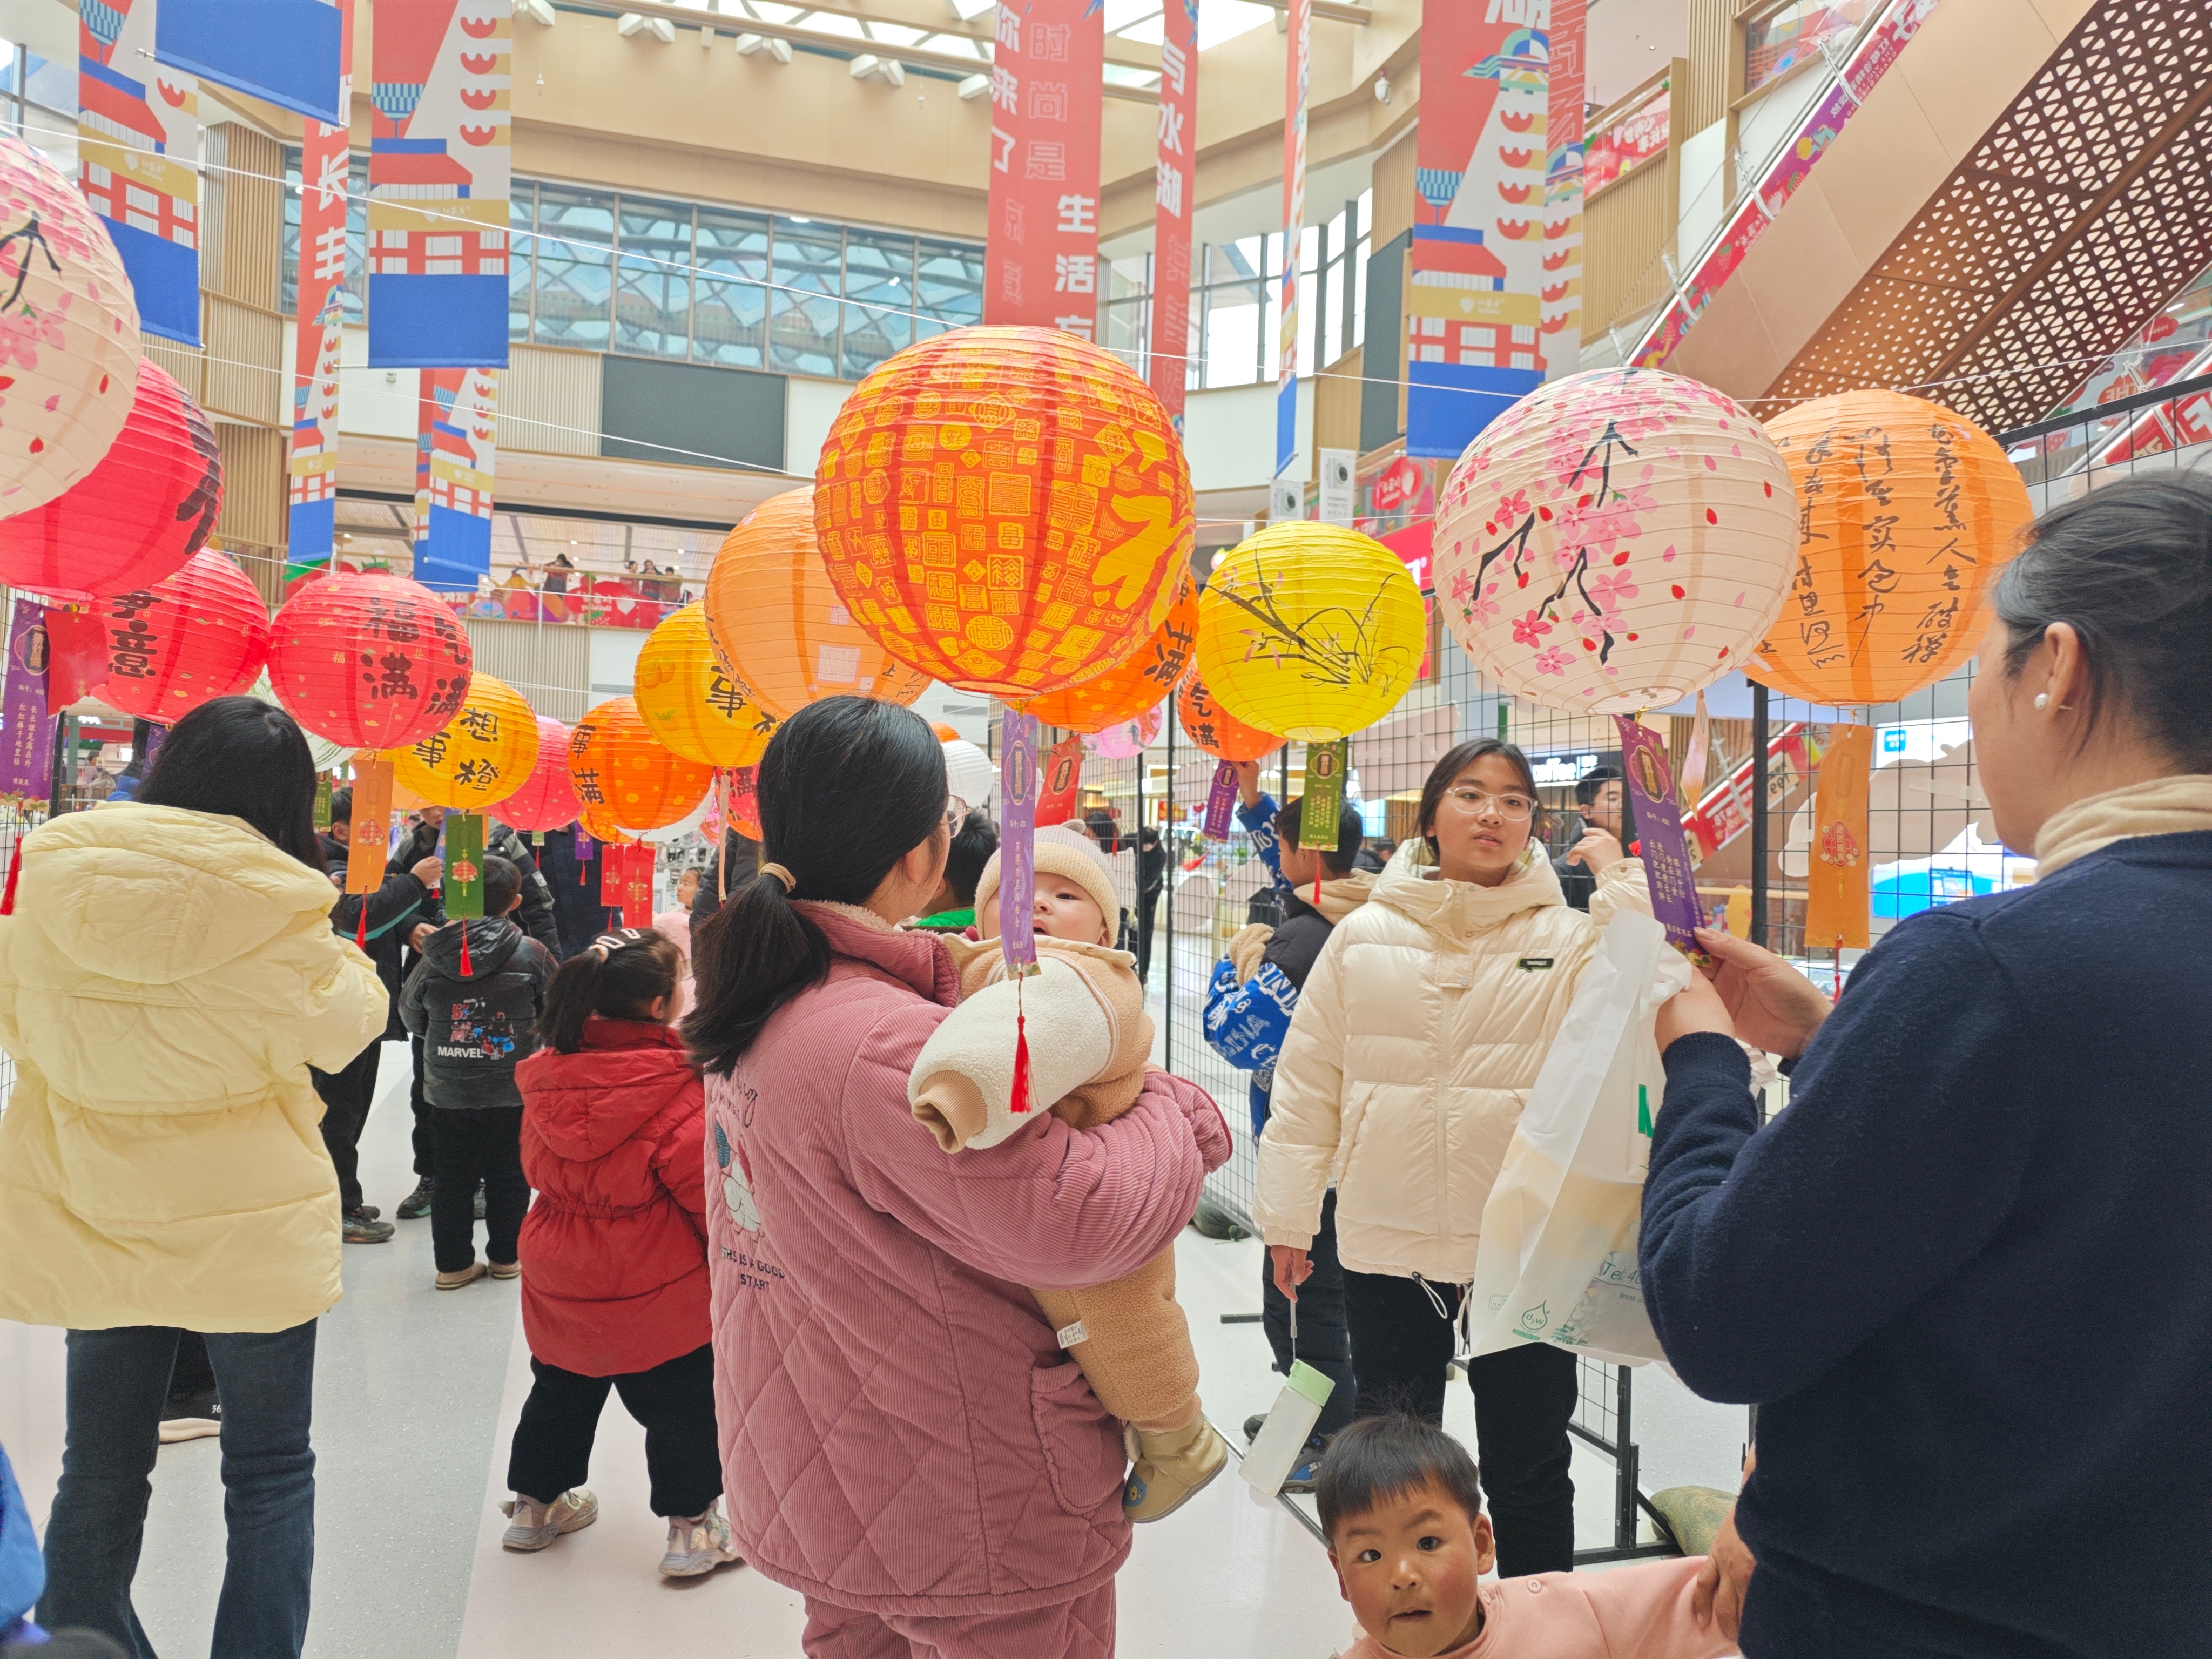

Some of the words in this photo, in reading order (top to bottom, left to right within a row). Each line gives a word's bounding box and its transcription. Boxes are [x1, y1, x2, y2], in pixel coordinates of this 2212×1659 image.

[437, 1045, 484, 1059] MARVEL
[757, 1260, 786, 1280] GOOD
[740, 1273, 770, 1292] START
